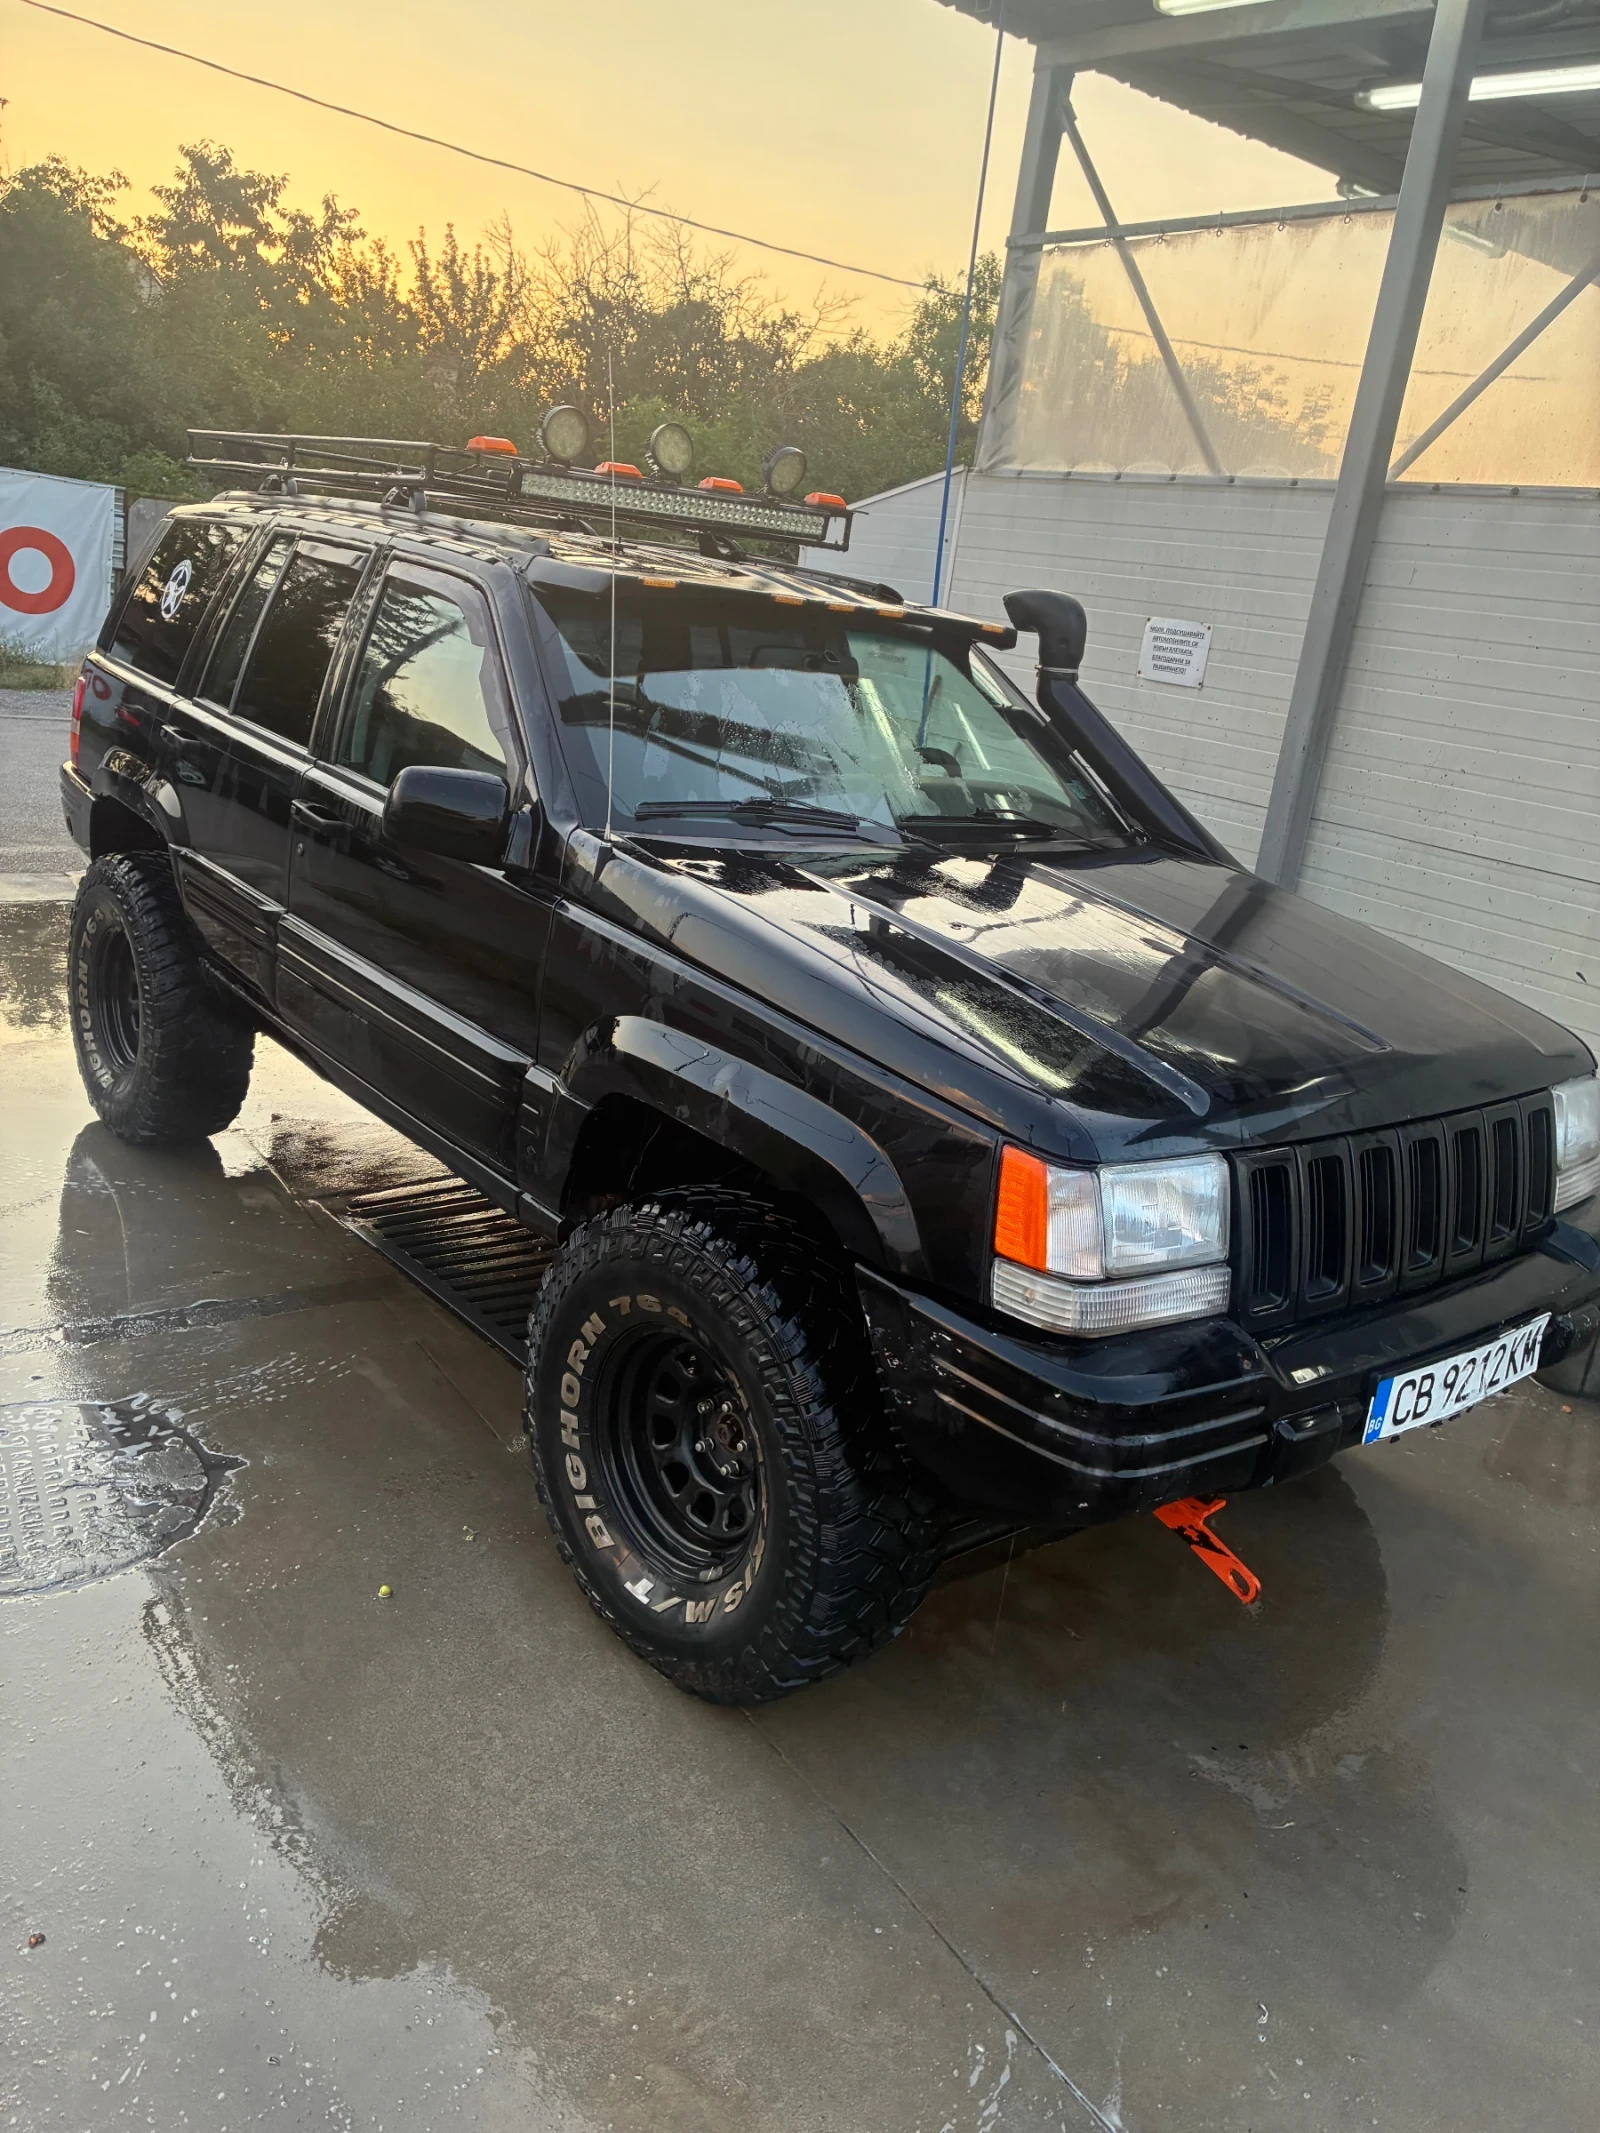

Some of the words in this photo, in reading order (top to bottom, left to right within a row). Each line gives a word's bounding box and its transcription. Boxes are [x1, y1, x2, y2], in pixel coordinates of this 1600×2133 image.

[78, 959, 115, 1089] BIGHORN
[560, 1311, 616, 1550] BIGHORN
[609, 1294, 692, 1328] 764
[1368, 1417, 1383, 1434] BG
[1392, 1372, 1436, 1427] CB
[1440, 1343, 1507, 1410] 9212
[1505, 1325, 1544, 1380] KM
[624, 1578, 718, 1624] M/T
